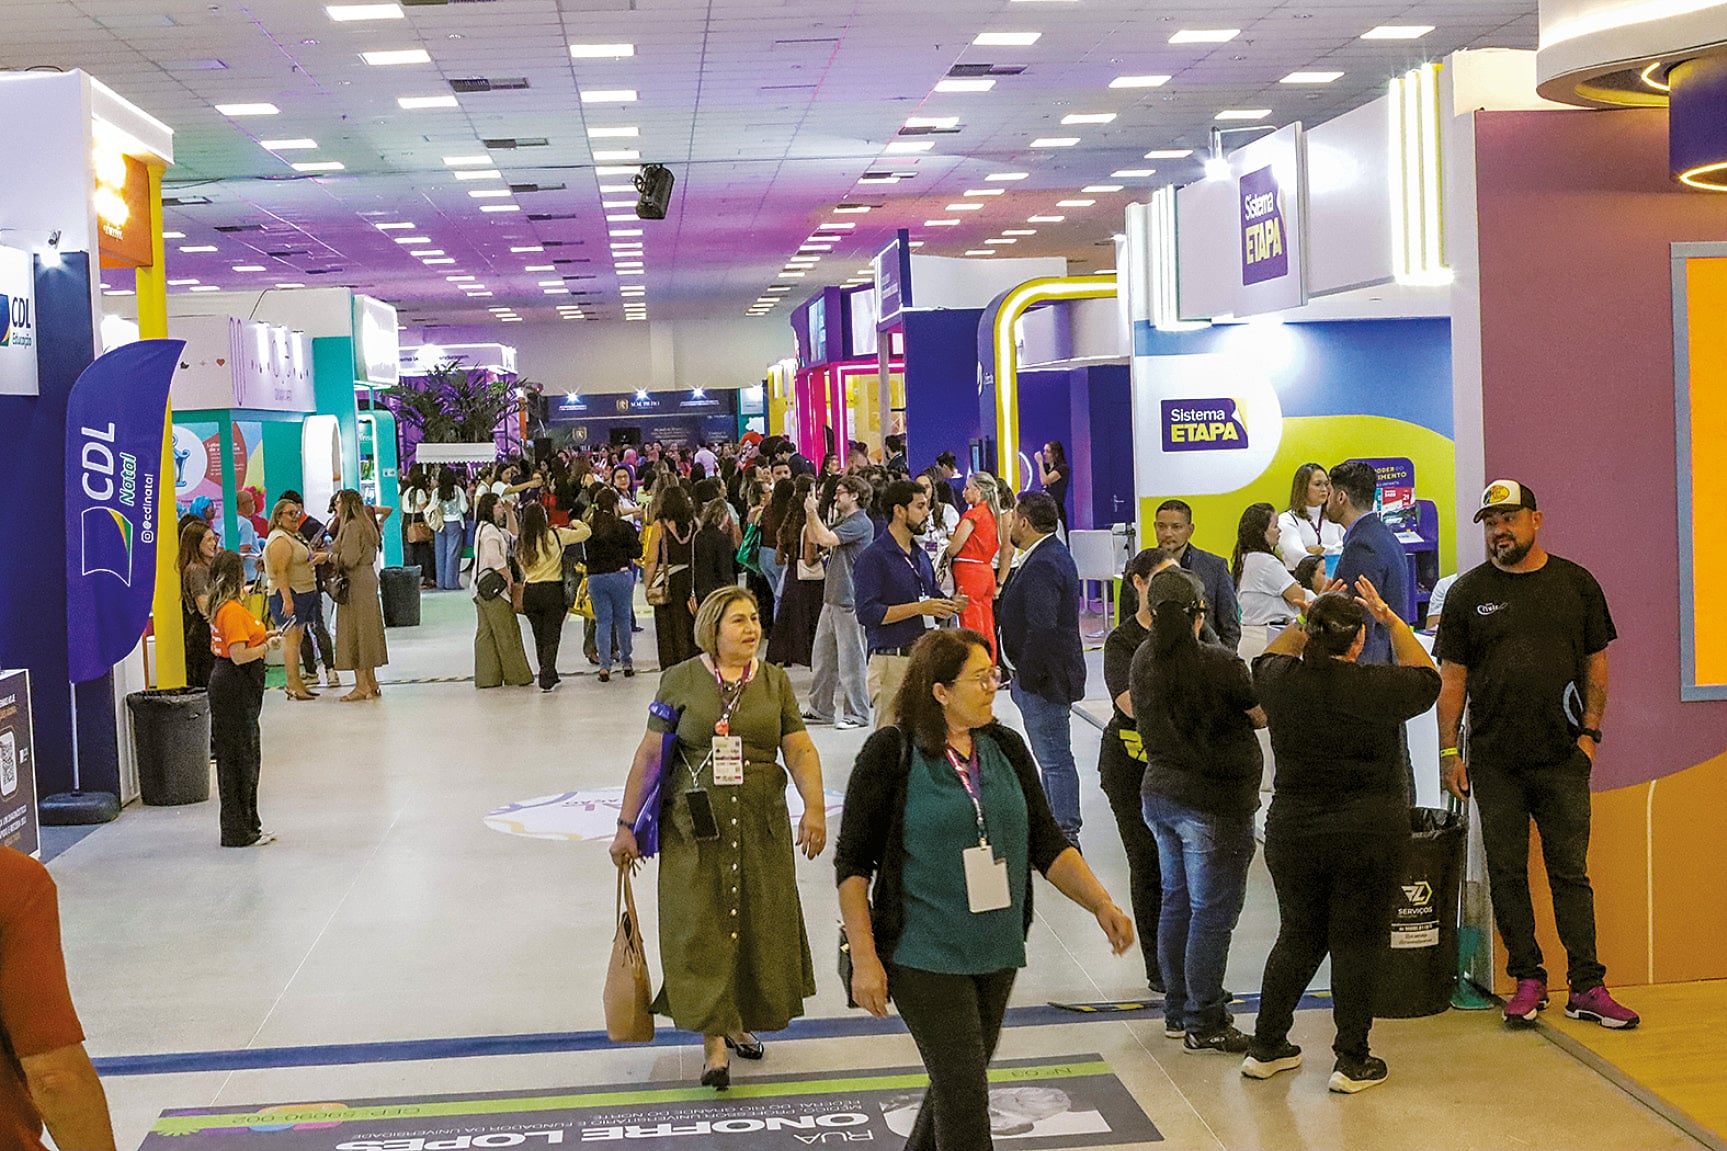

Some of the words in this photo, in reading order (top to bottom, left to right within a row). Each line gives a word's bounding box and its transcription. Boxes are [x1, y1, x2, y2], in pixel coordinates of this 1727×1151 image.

[1245, 192, 1274, 220] Sistema
[1245, 217, 1282, 264] ETAPA
[12, 296, 32, 329] CDL
[1170, 408, 1225, 422] Sistema
[1170, 421, 1239, 442] ETAPA
[81, 422, 115, 501] CDL
[119, 451, 137, 507] Natal
[142, 473, 154, 530] @cdlnatal
[1398, 906, 1433, 916] SERVIÇOS
[674, 1106, 737, 1115] GRANDE
[739, 1105, 766, 1113] RIO
[799, 1099, 861, 1109] FEDERAL
[702, 1109, 796, 1119] PROFESSOR
[353, 1127, 461, 1139] UNIVERSIDADE
[464, 1126, 485, 1134] DA
[491, 1121, 573, 1132] FUNDADOR
[581, 1112, 870, 1142] ONOFRE
[335, 1129, 564, 1151] LOPES
[793, 1129, 874, 1145] RUA
